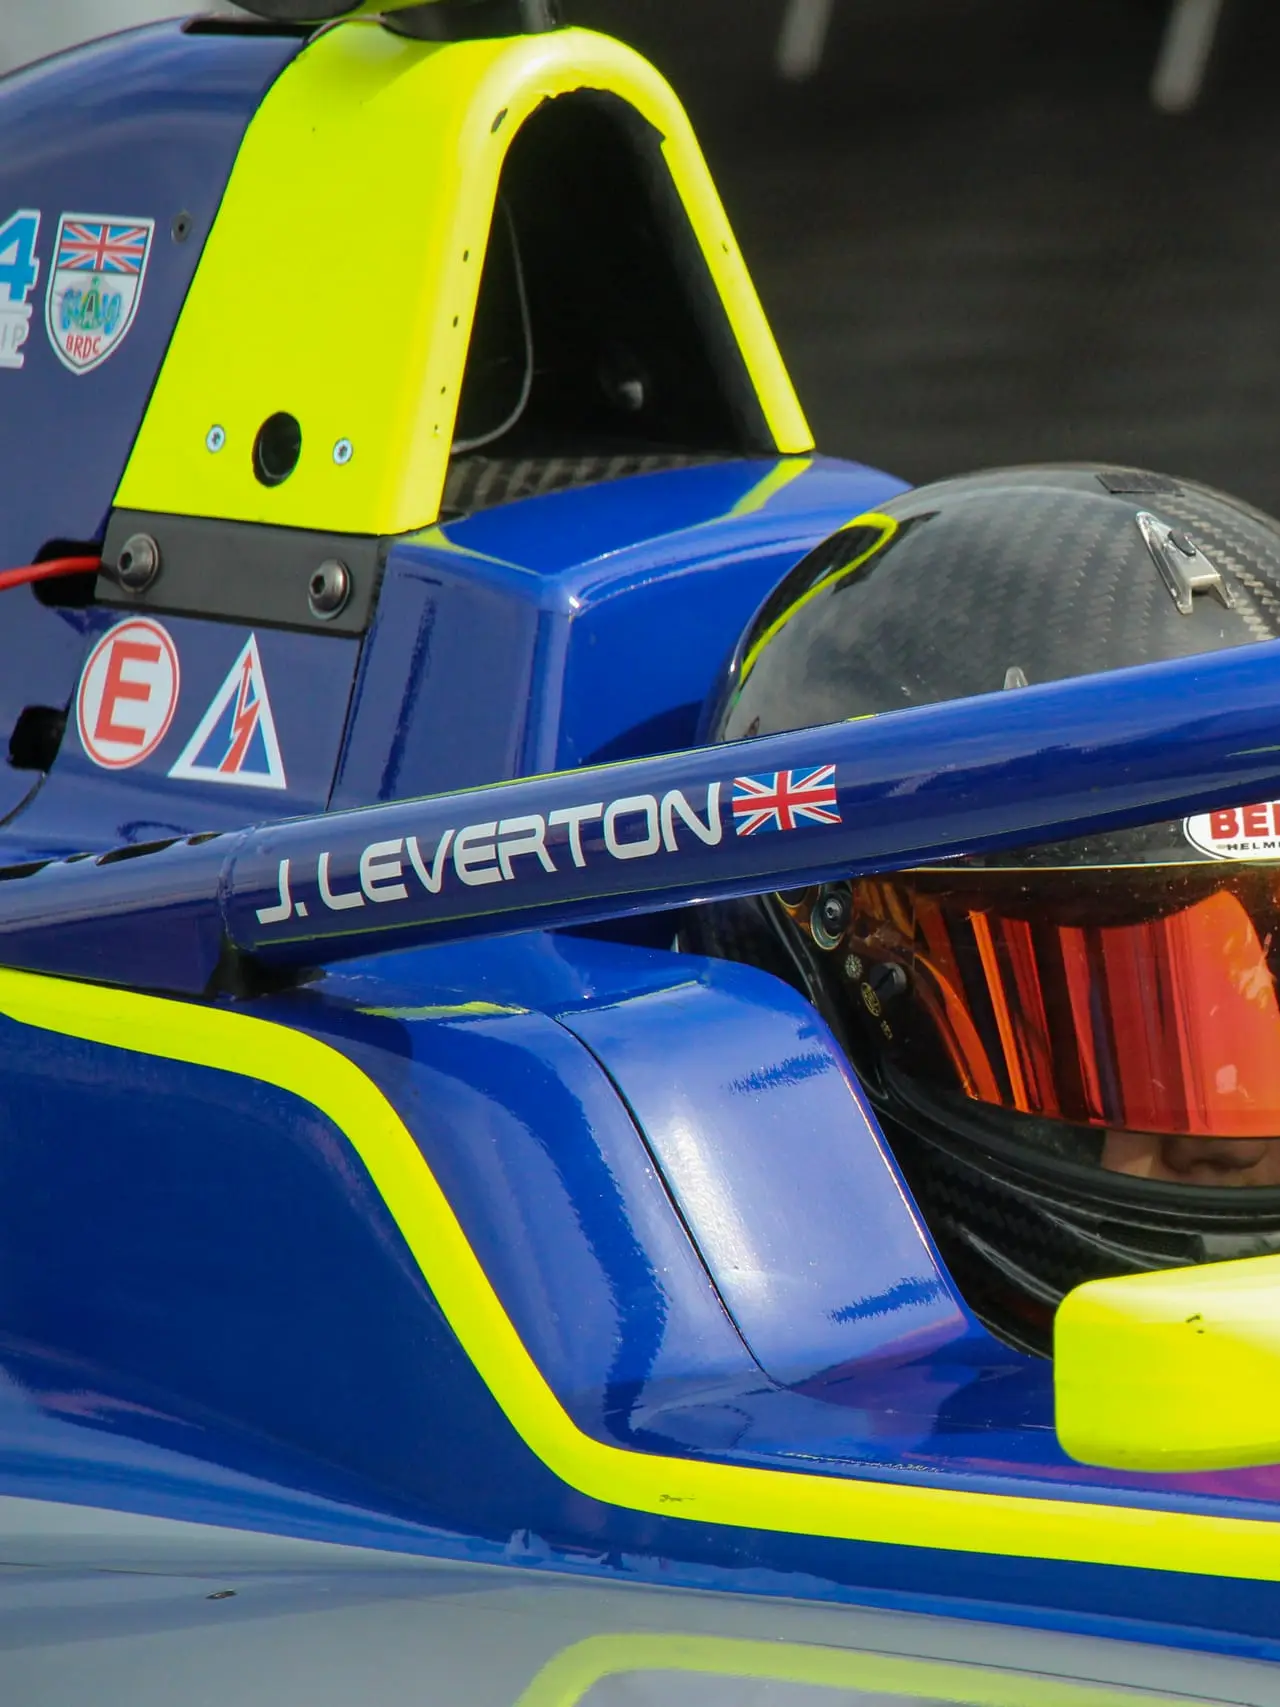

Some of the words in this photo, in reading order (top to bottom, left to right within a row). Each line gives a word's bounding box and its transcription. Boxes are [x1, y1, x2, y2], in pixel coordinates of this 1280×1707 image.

[65, 333, 102, 361] BRDC
[93, 638, 162, 747] E
[316, 781, 722, 911] LEVERTON
